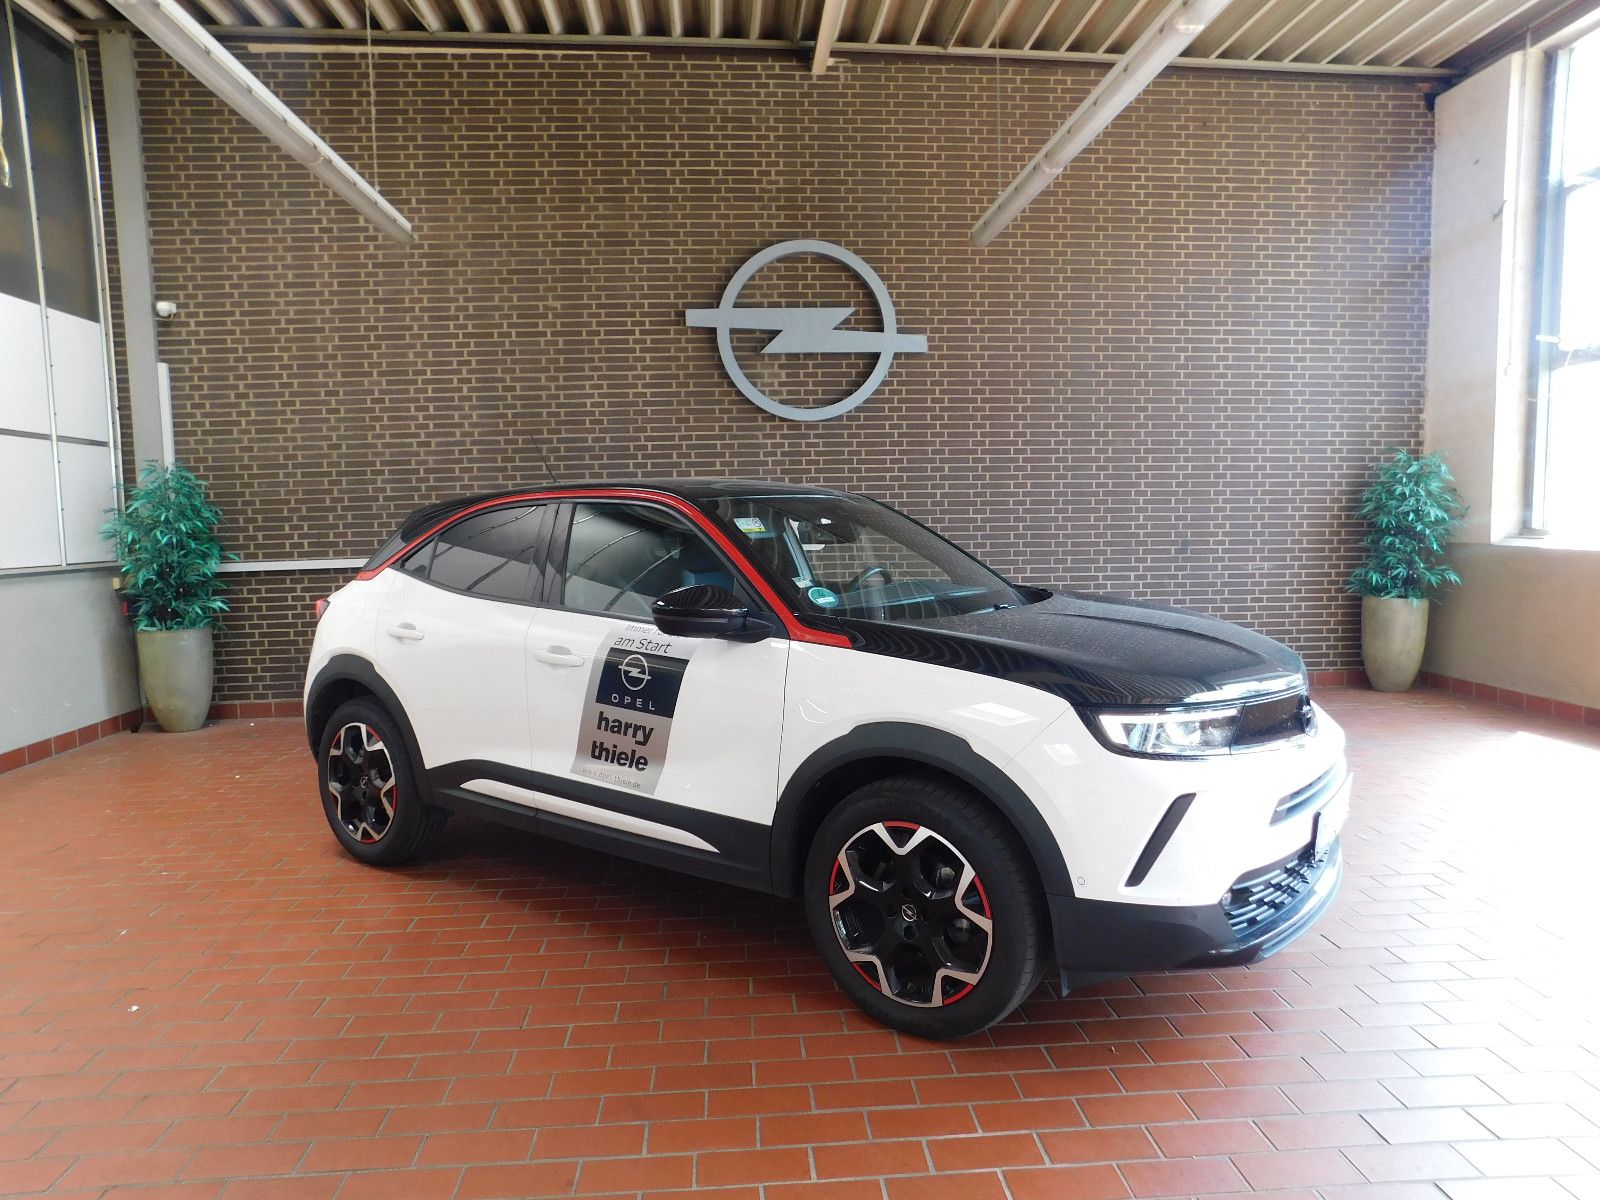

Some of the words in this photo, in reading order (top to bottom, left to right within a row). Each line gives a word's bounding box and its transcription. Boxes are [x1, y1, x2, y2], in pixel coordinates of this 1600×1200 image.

[614, 636, 635, 647] am
[636, 638, 672, 654] Start
[611, 693, 656, 711] OPEL
[597, 711, 654, 746] harry
[590, 740, 649, 772] thiele
